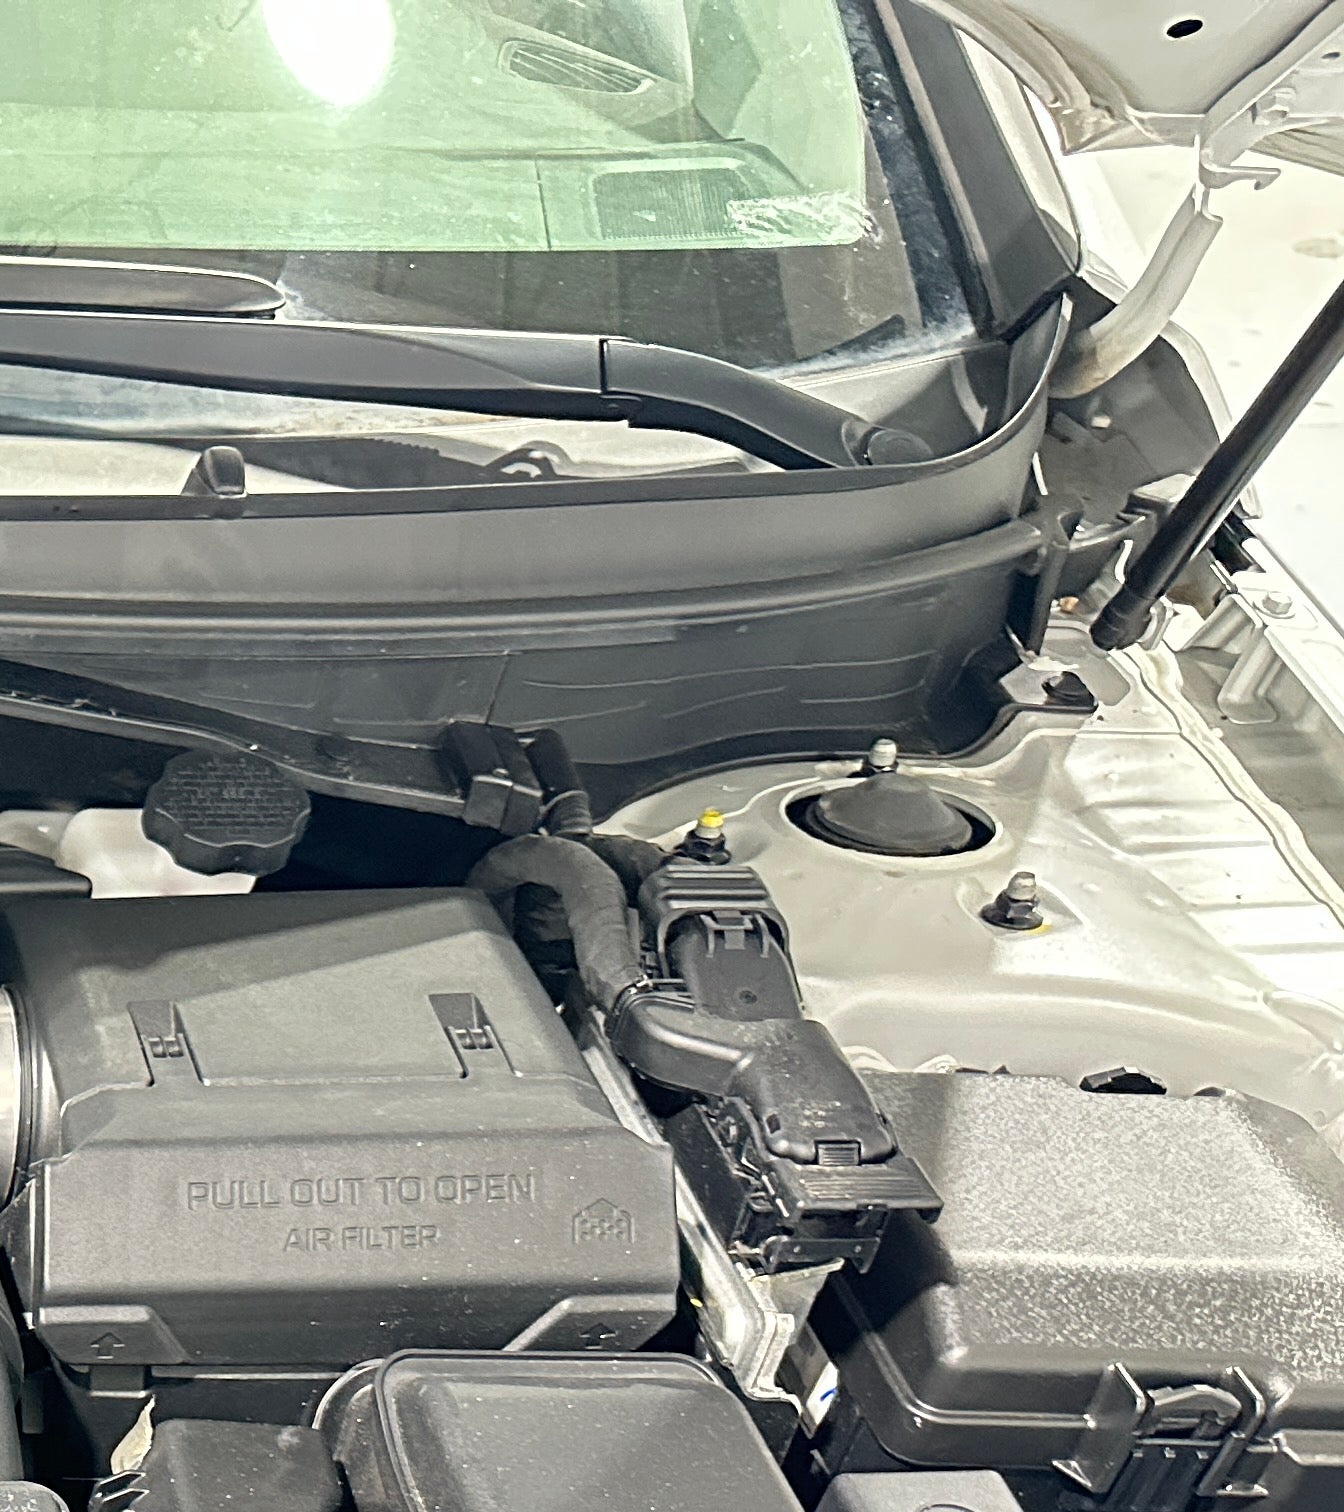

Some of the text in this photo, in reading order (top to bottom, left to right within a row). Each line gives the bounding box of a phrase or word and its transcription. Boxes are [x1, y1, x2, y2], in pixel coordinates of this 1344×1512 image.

[187, 1173, 535, 1210] PULL OUT TO OPEN
[283, 1224, 440, 1252] AIR FILTER
